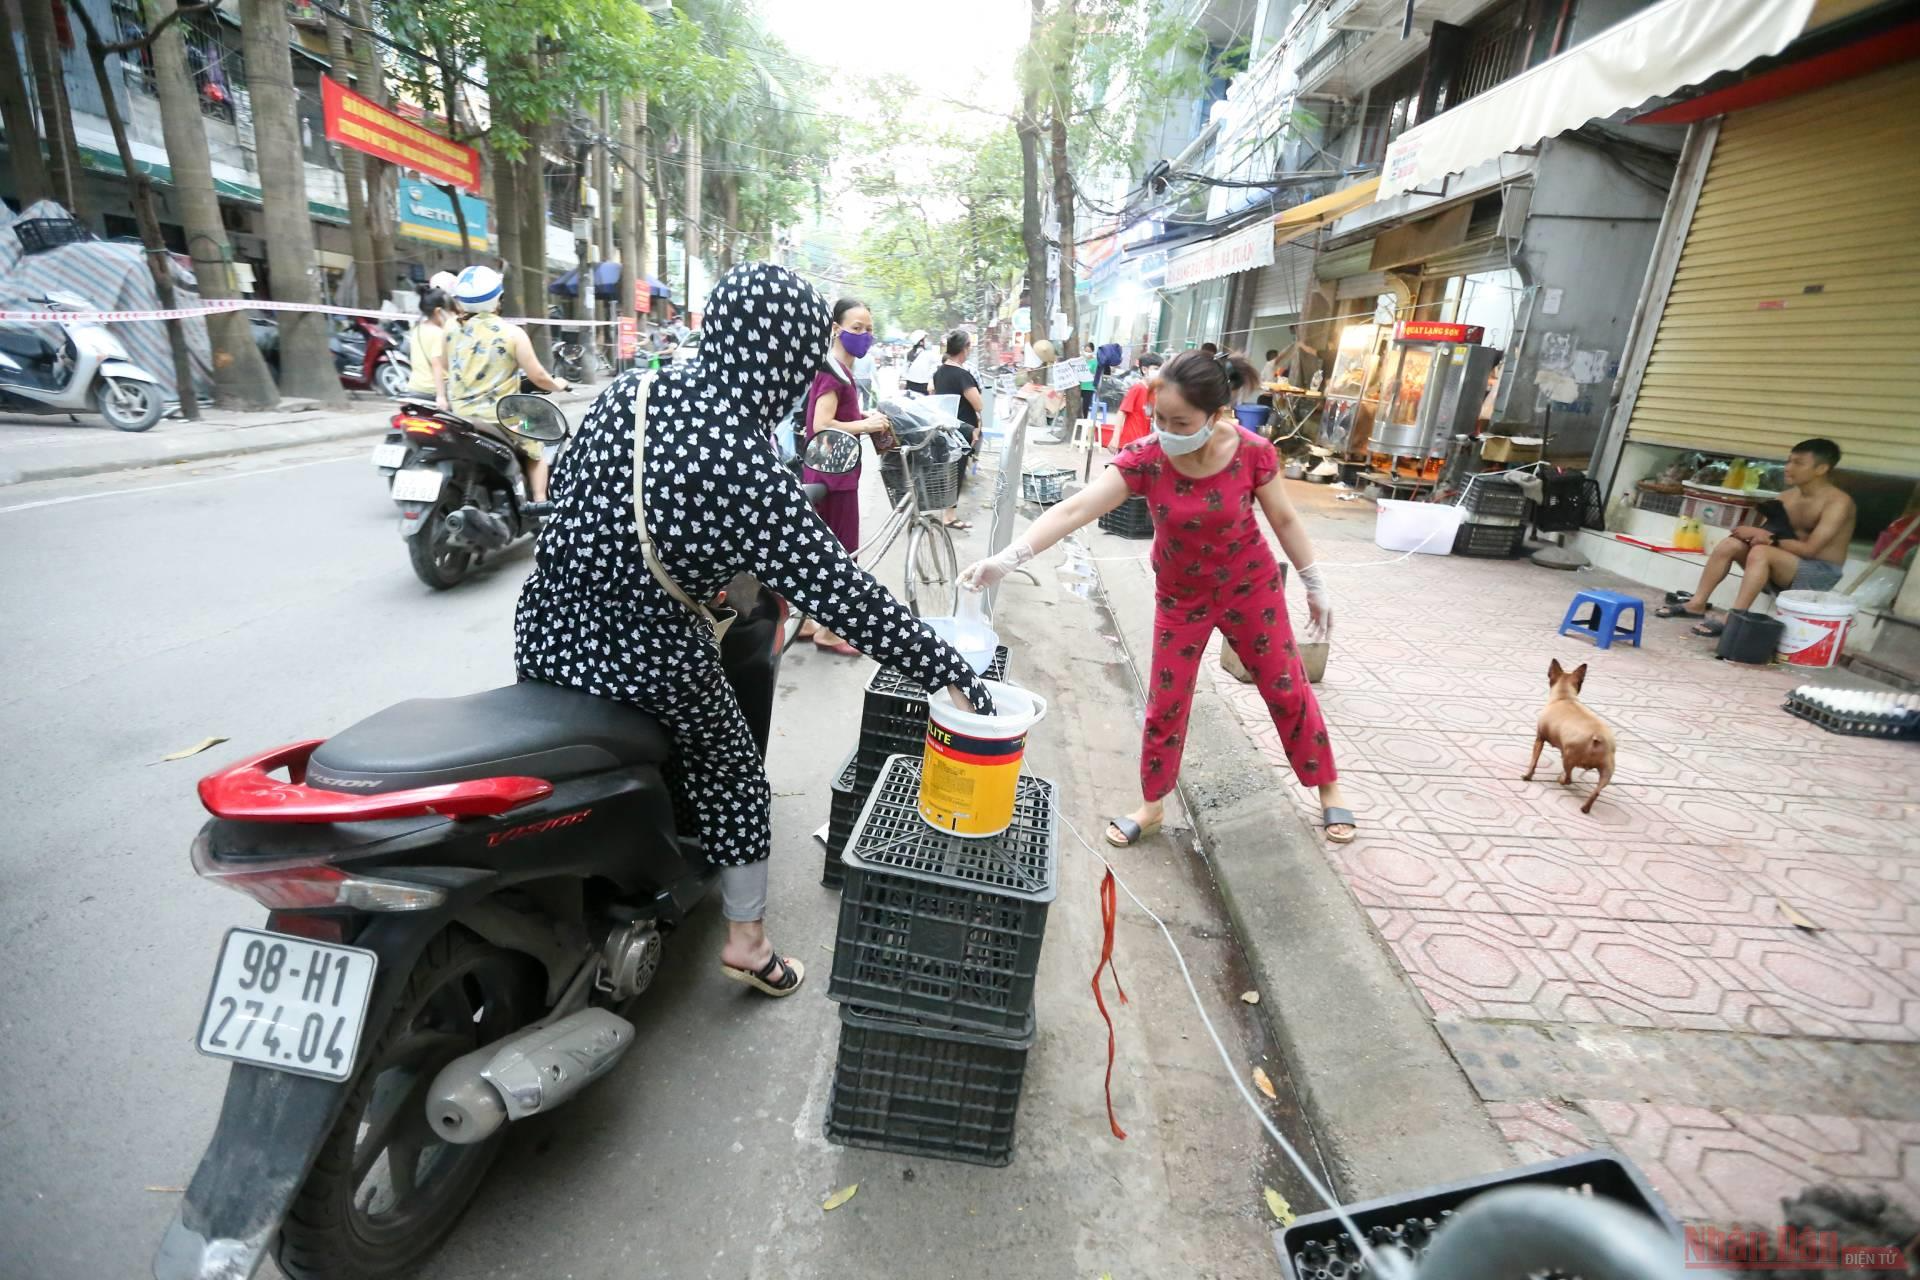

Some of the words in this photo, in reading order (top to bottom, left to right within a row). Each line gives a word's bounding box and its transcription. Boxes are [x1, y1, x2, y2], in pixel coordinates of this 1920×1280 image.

[309, 768, 383, 788] VISION
[238, 939, 350, 1007] 98-H1
[209, 996, 347, 1069] 274.04
